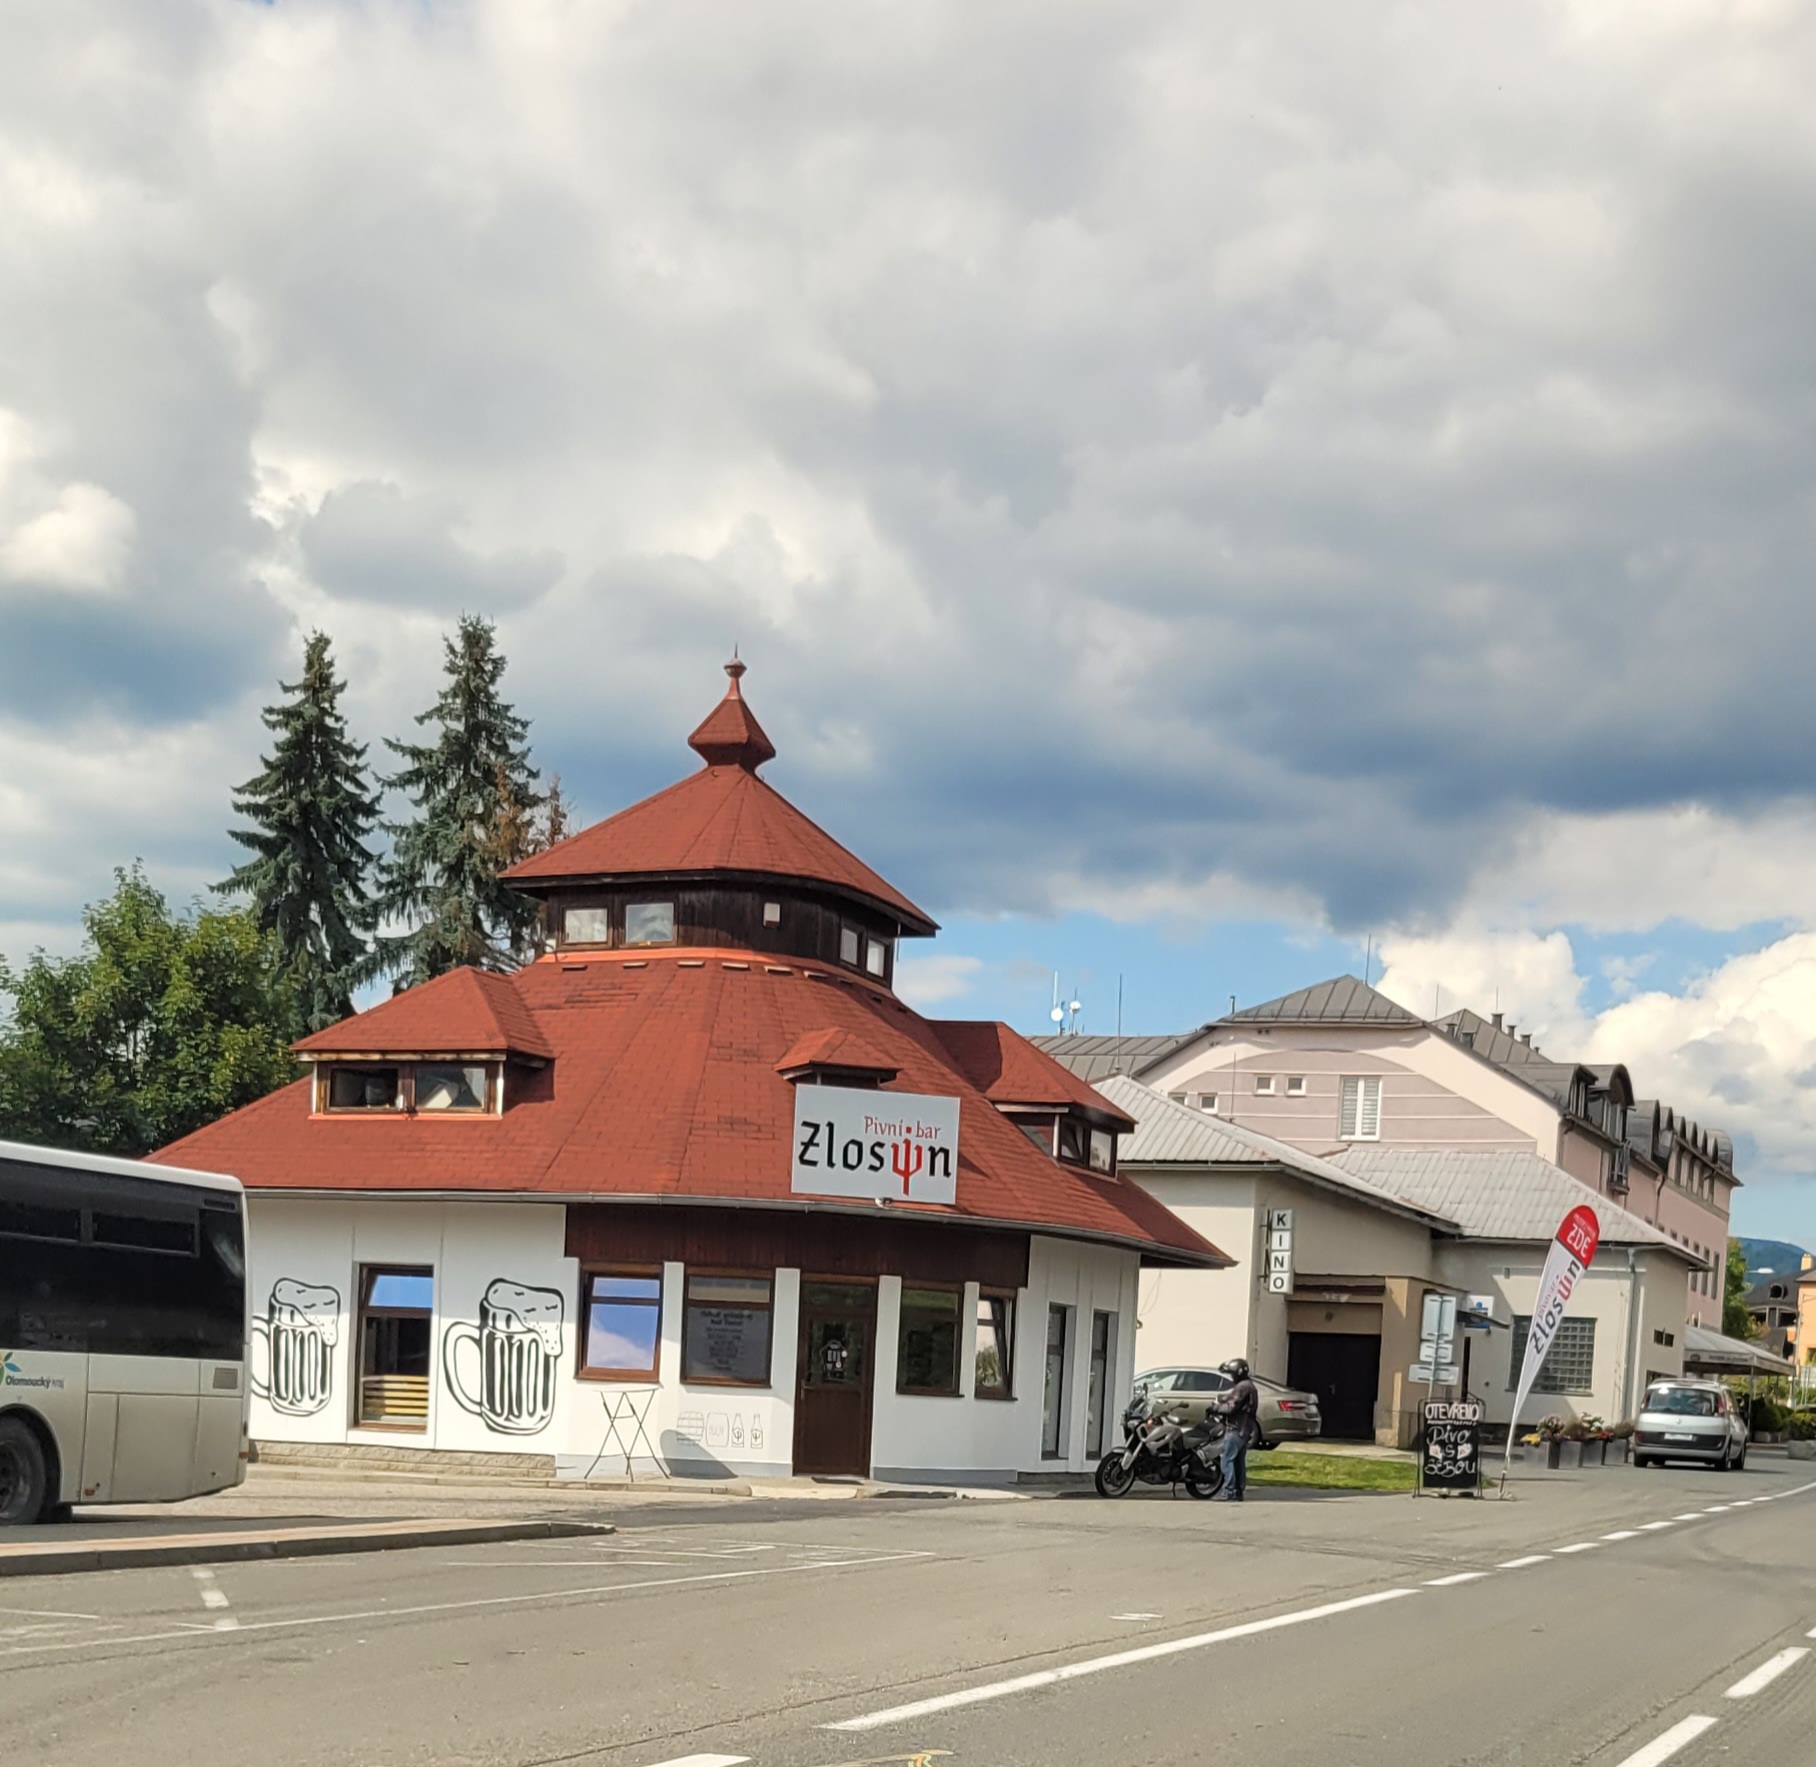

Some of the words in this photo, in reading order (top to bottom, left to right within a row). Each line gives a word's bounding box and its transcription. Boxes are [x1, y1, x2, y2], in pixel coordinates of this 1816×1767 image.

[864, 1115, 904, 1137] Pivní
[915, 1120, 941, 1140] bar
[1273, 1213, 1287, 1289] KINO
